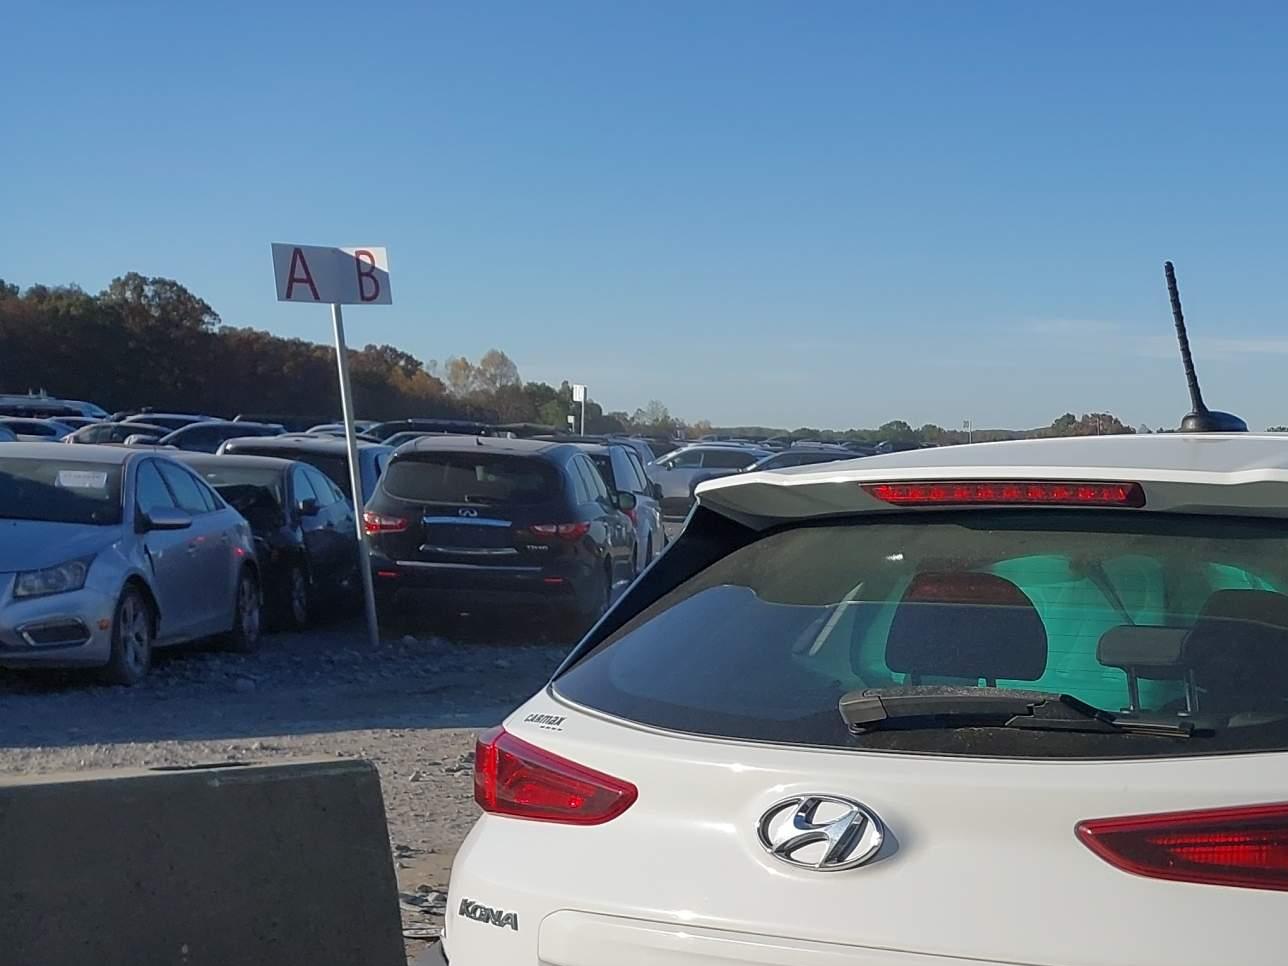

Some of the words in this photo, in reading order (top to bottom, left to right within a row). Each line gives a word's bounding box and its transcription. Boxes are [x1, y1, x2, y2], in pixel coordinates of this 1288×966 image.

[286, 247, 321, 301] A
[354, 249, 380, 302] B
[458, 897, 519, 931] KONA
